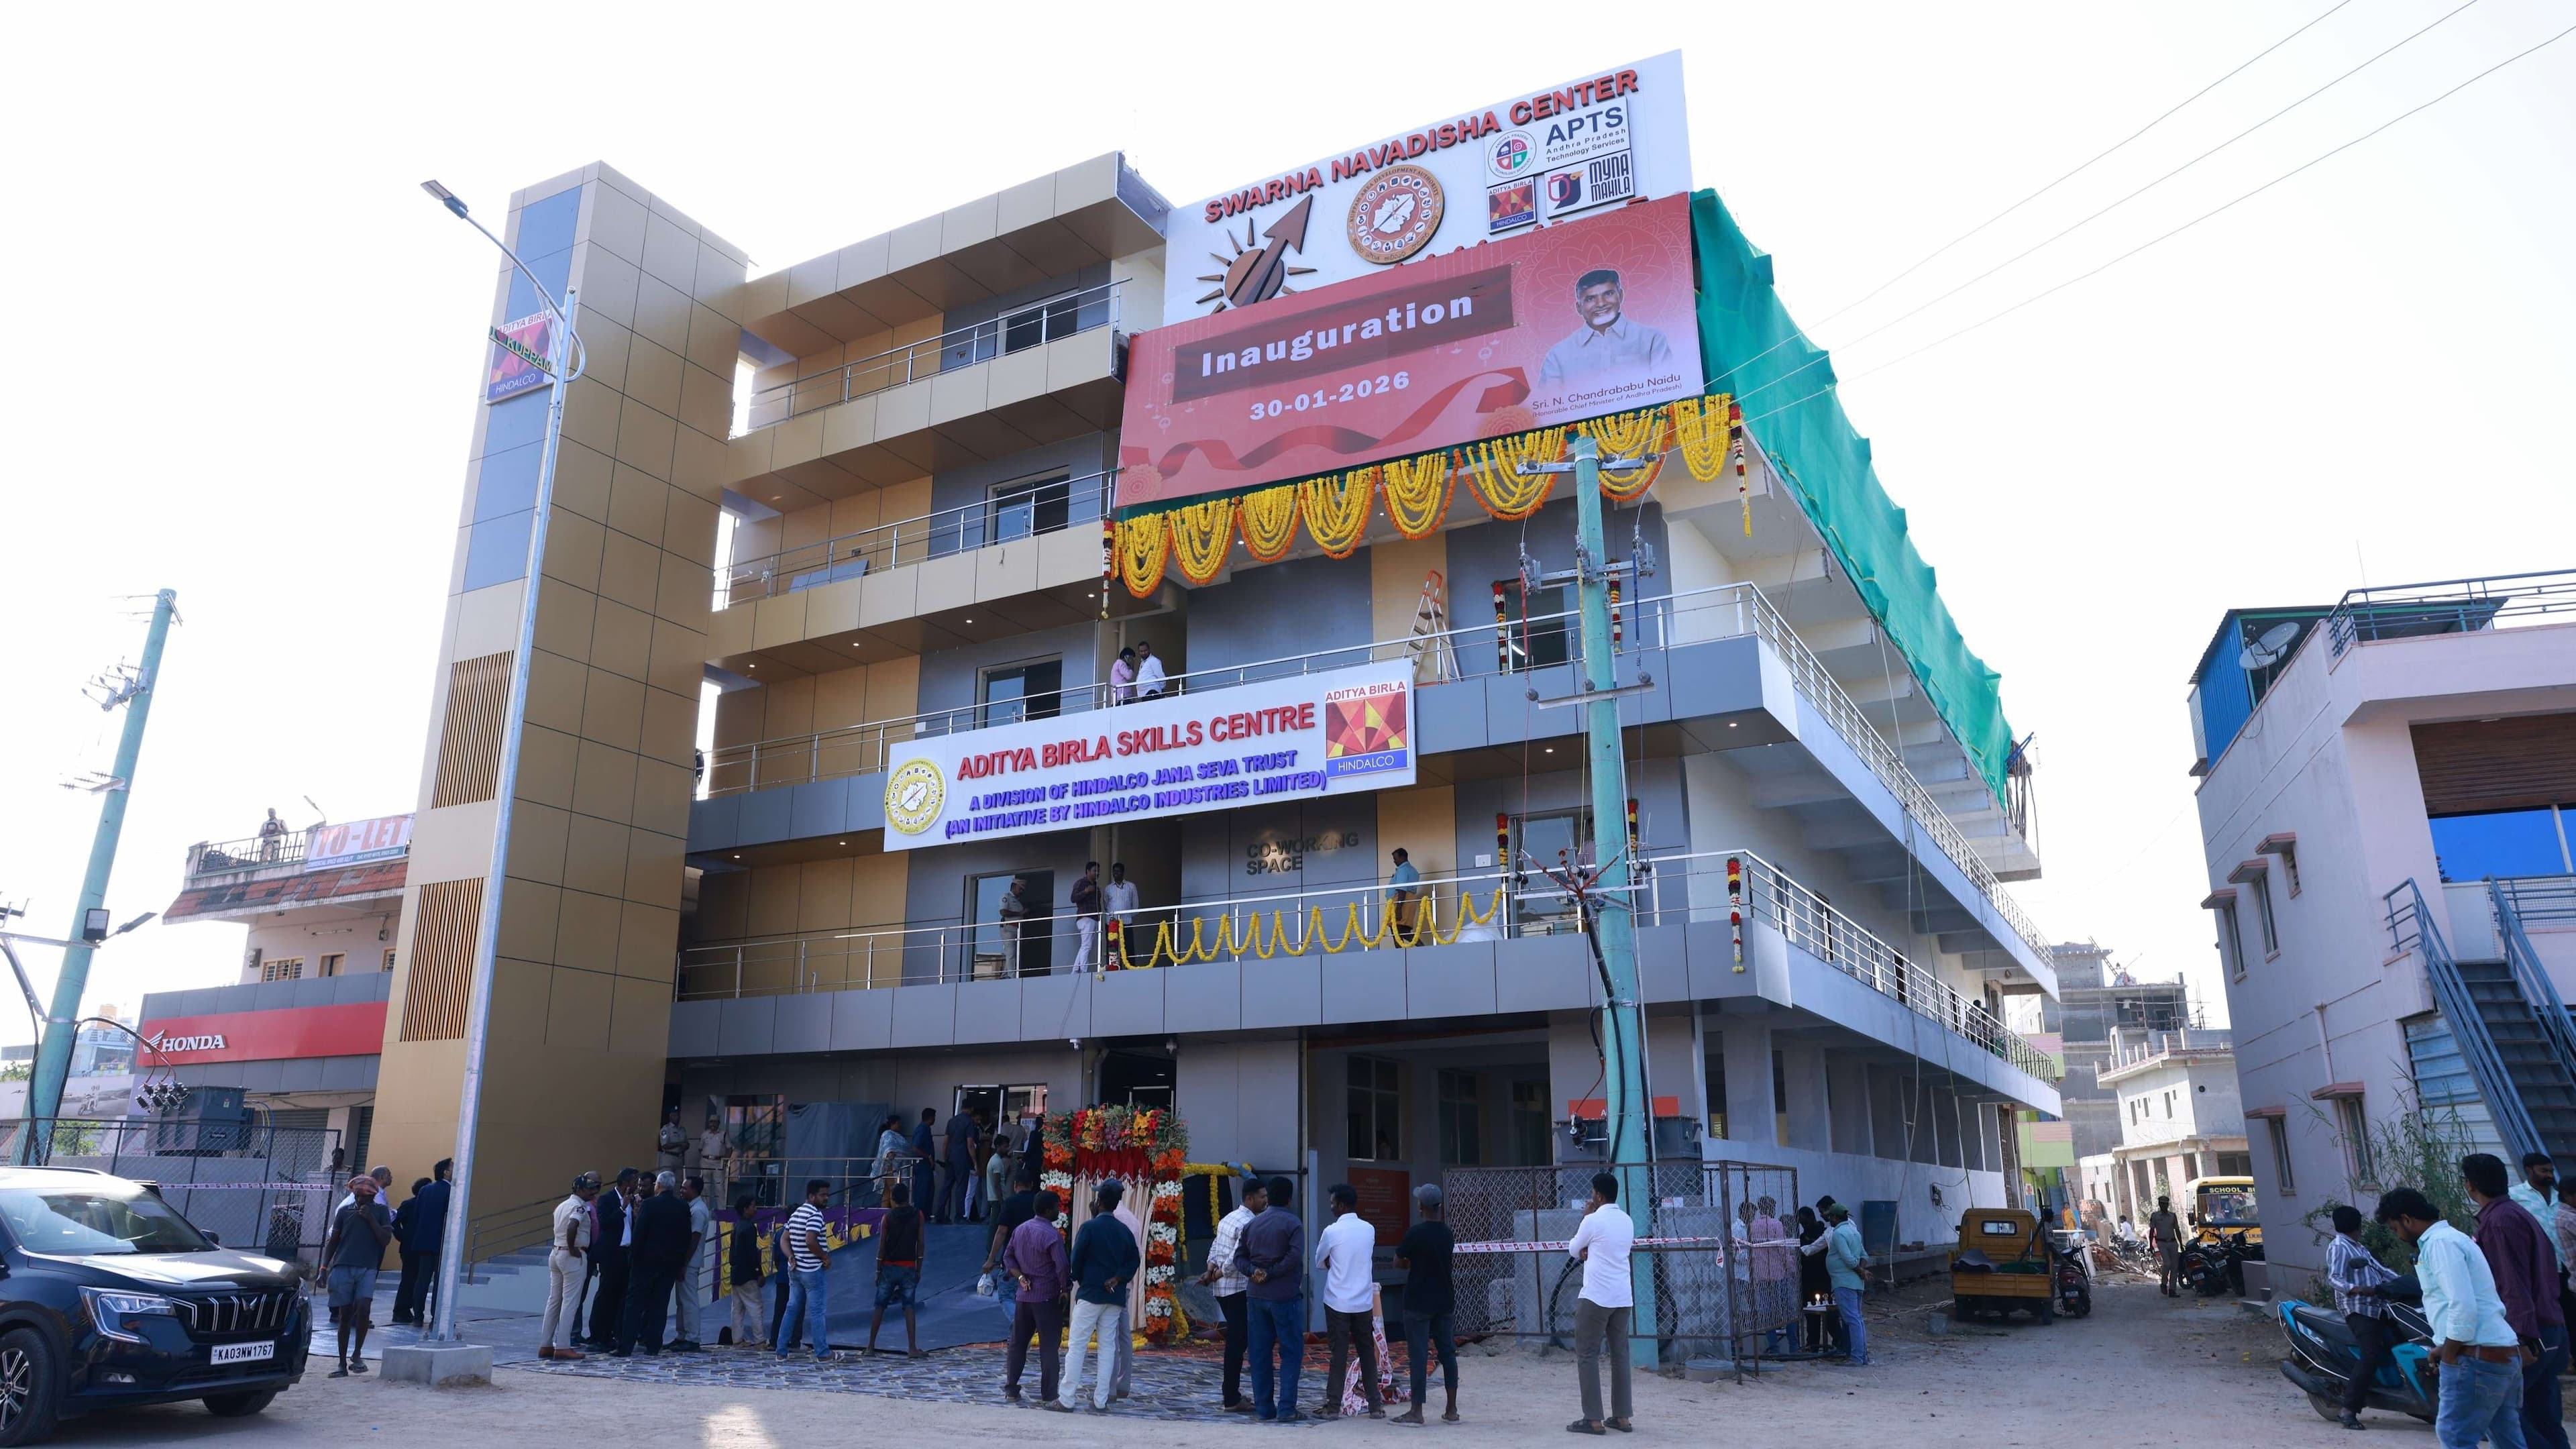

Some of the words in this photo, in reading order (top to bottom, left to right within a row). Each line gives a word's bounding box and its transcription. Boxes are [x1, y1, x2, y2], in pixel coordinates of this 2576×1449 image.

[1546, 107, 1623, 146] APTS
[1546, 140, 1580, 155] Andhra
[1585, 127, 1626, 145] Pradesh
[1205, 167, 1324, 223] SWARNA
[1332, 111, 1501, 182] NAVADISHA
[1509, 69, 1638, 126] CENTER
[1546, 147, 1589, 163] Technology
[1592, 138, 1625, 151] Services
[1489, 184, 1512, 195] ADITYA
[1513, 179, 1533, 189] BIRLA
[1591, 176, 1631, 203] MAHILA
[1497, 214, 1527, 227] HINDALCO
[1201, 297, 1472, 377] Inauguration
[506, 335, 553, 372] KUPPAM
[496, 373, 536, 394] HINDALCO
[1249, 371, 1409, 421] 30-01-2026
[1532, 400, 1550, 411] Sri.
[1553, 396, 1564, 406] N.
[1568, 382, 1644, 402] Chandrababu
[1648, 374, 1681, 388] Naidu
[1532, 405, 1568, 418] (Honorable
[1571, 402, 1587, 411] Chief
[1589, 397, 1615, 408] Minister
[1625, 390, 1651, 400] Andhra
[1652, 383, 1682, 395] Pradesh)
[1326, 686, 1366, 702] ADITYA
[1368, 681, 1406, 696] BIRLA
[957, 747, 1037, 781] ADITYA
[1042, 735, 1112, 769] BIRLA
[1116, 721, 1203, 757] SKILLS
[1210, 702, 1316, 743] CENTRE
[1338, 754, 1395, 773] HINDALCO
[969, 796, 980, 812] A
[983, 786, 1046, 810] DIVISION
[1049, 783, 1069, 800] OF
[1071, 770, 1148, 797] HINDALCO
[1151, 765, 1193, 786] JANA
[1196, 758, 1239, 780] SEVA
[1242, 750, 1298, 773] TRUST
[945, 818, 970, 839] (AN
[973, 808, 1047, 833] INITIATIVE
[1049, 805, 1071, 823] BY
[1073, 794, 1150, 819] HINDALCO
[1153, 780, 1249, 808] INDUSTRIES
[1253, 769, 1328, 796] LIMITED)
[317, 815, 409, 857] TO-LET
[1246, 832, 1359, 859] CO-WORKING
[1246, 855, 1303, 875] SPACE
[161, 1034, 225, 1053] HONDA
